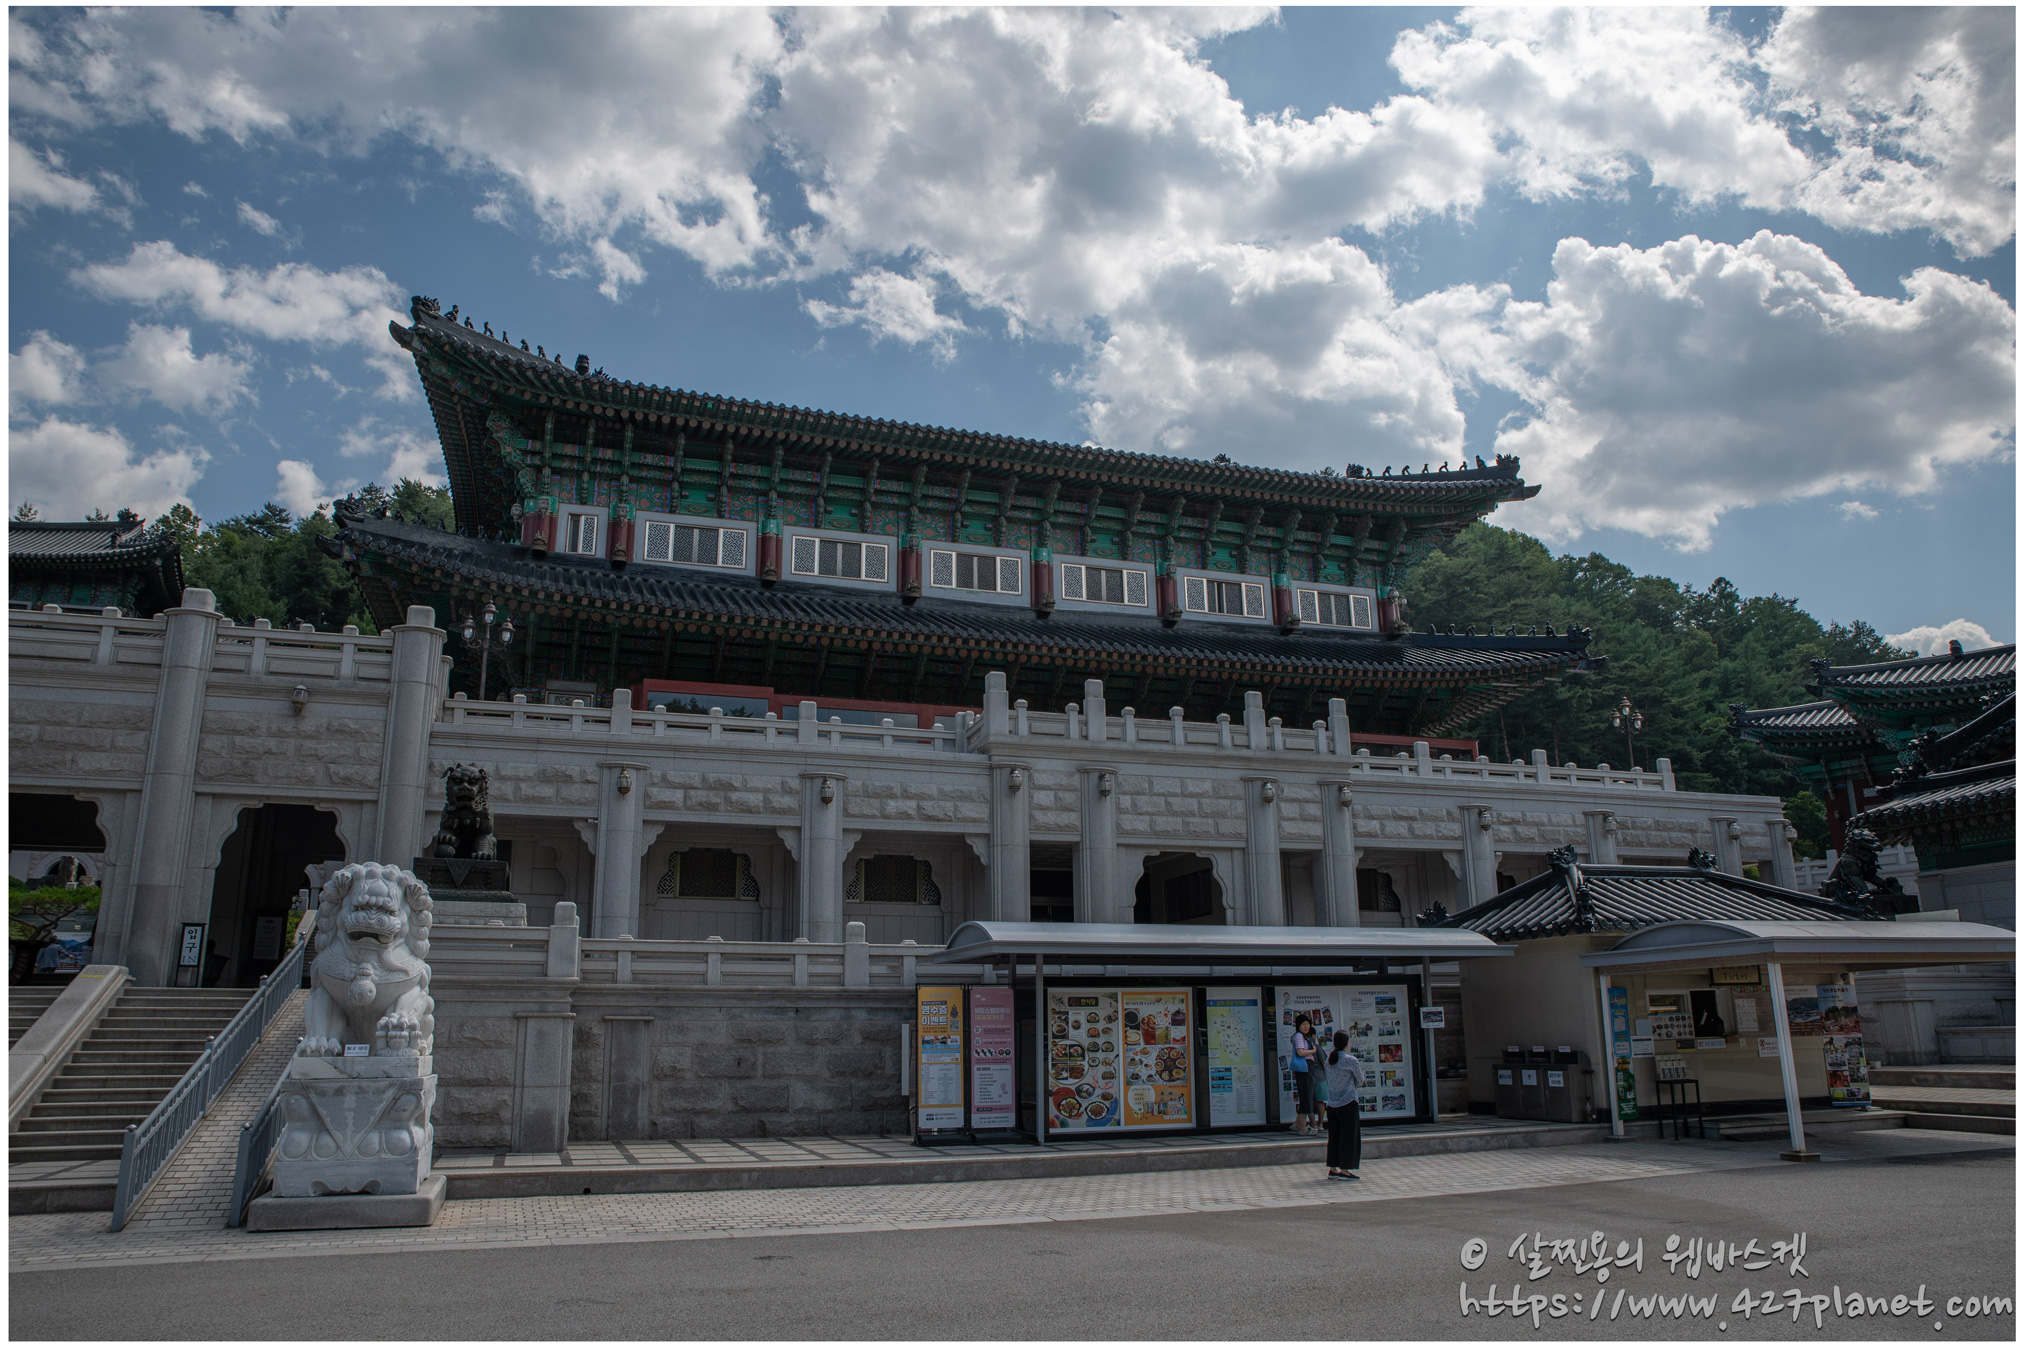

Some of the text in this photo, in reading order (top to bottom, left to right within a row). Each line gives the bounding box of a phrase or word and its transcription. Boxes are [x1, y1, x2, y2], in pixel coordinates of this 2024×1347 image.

[186, 929, 198, 953] 입구
[1722, 972, 1748, 981] Ticket
[1081, 998, 1096, 1006] 한식당
[922, 1005, 948, 1015] 영수증
[922, 1016, 948, 1025] 이벤트
